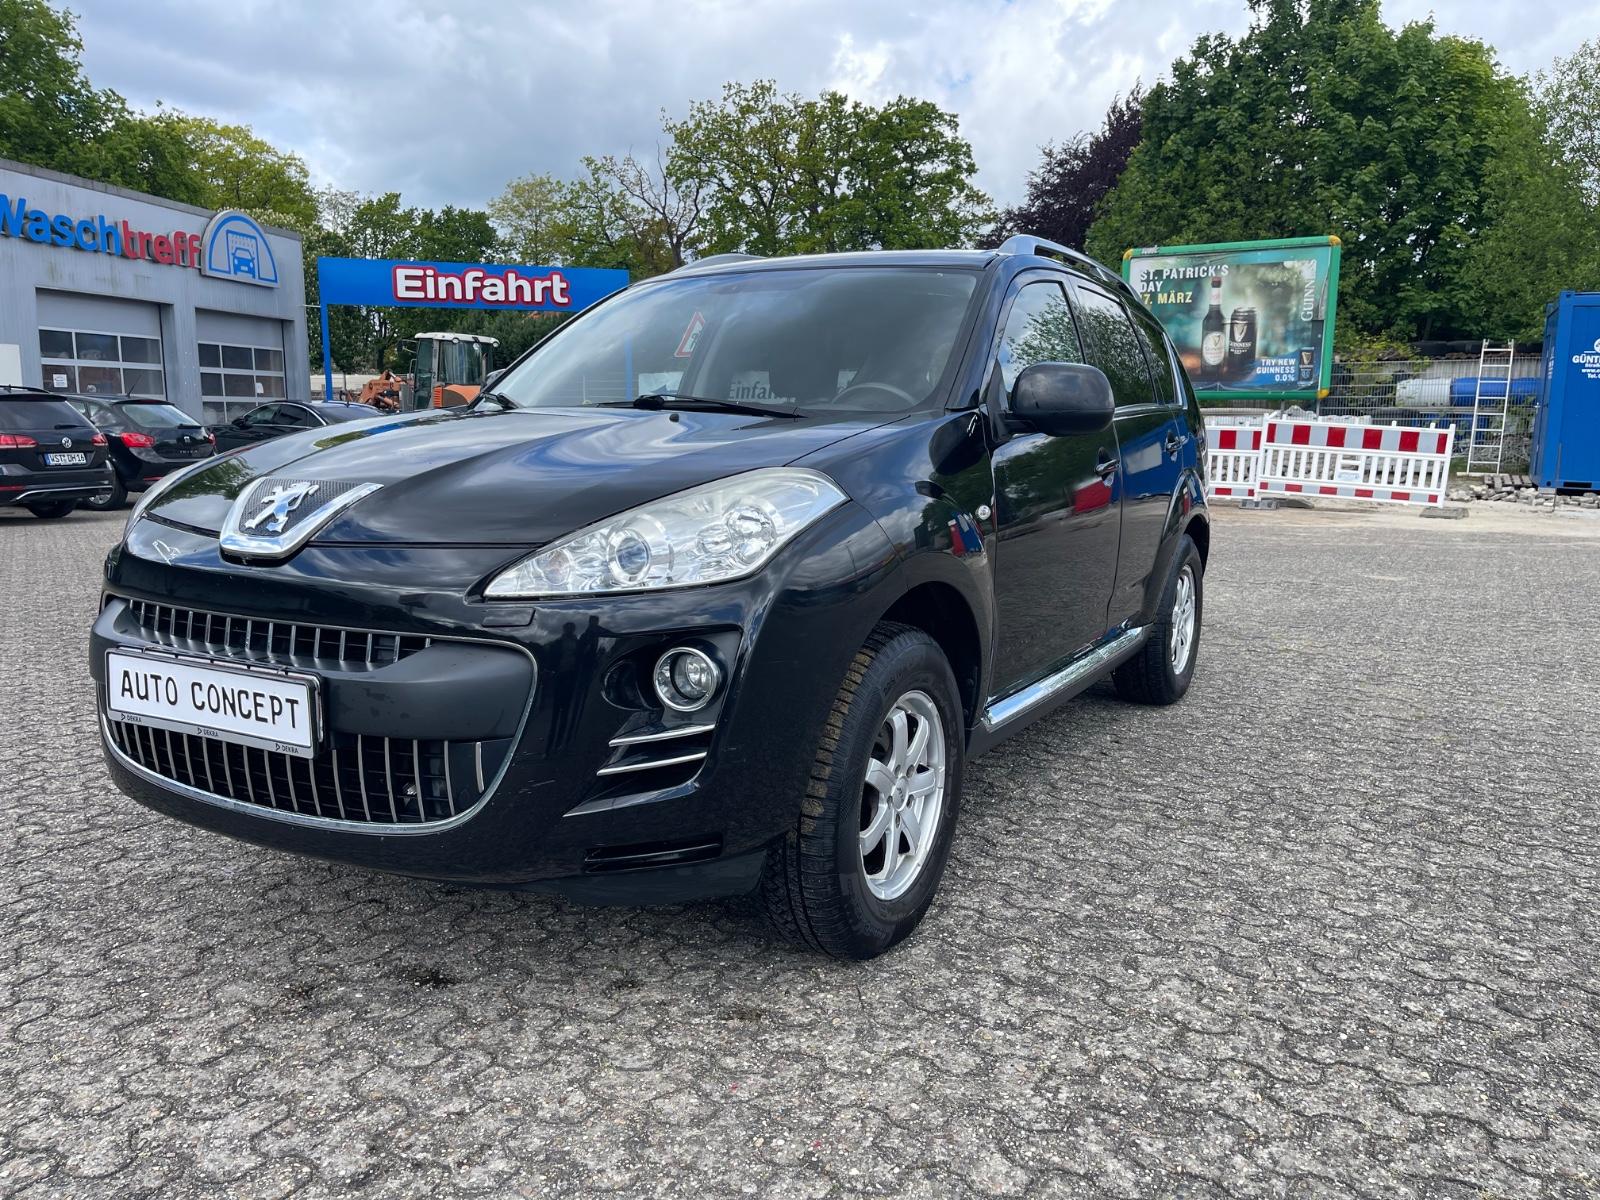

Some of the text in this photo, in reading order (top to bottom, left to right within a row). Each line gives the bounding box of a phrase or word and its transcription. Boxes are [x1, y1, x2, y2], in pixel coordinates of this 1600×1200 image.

[0, 194, 200, 268] Waschtreff
[1140, 264, 1229, 280] ST. PATRICK'S
[395, 268, 569, 304] Einfahrt
[1140, 281, 1163, 292] DAY
[1157, 290, 1193, 304] MÄRZ
[1279, 358, 1296, 366] NEW
[1572, 353, 1600, 364] GÜNT
[1256, 366, 1295, 374] GUINNESS
[121, 670, 300, 729] AUTO CONCEPT
[126, 715, 142, 723] DEKRA
[203, 728, 219, 738] DEKRA
[281, 744, 300, 754] DEKRA
